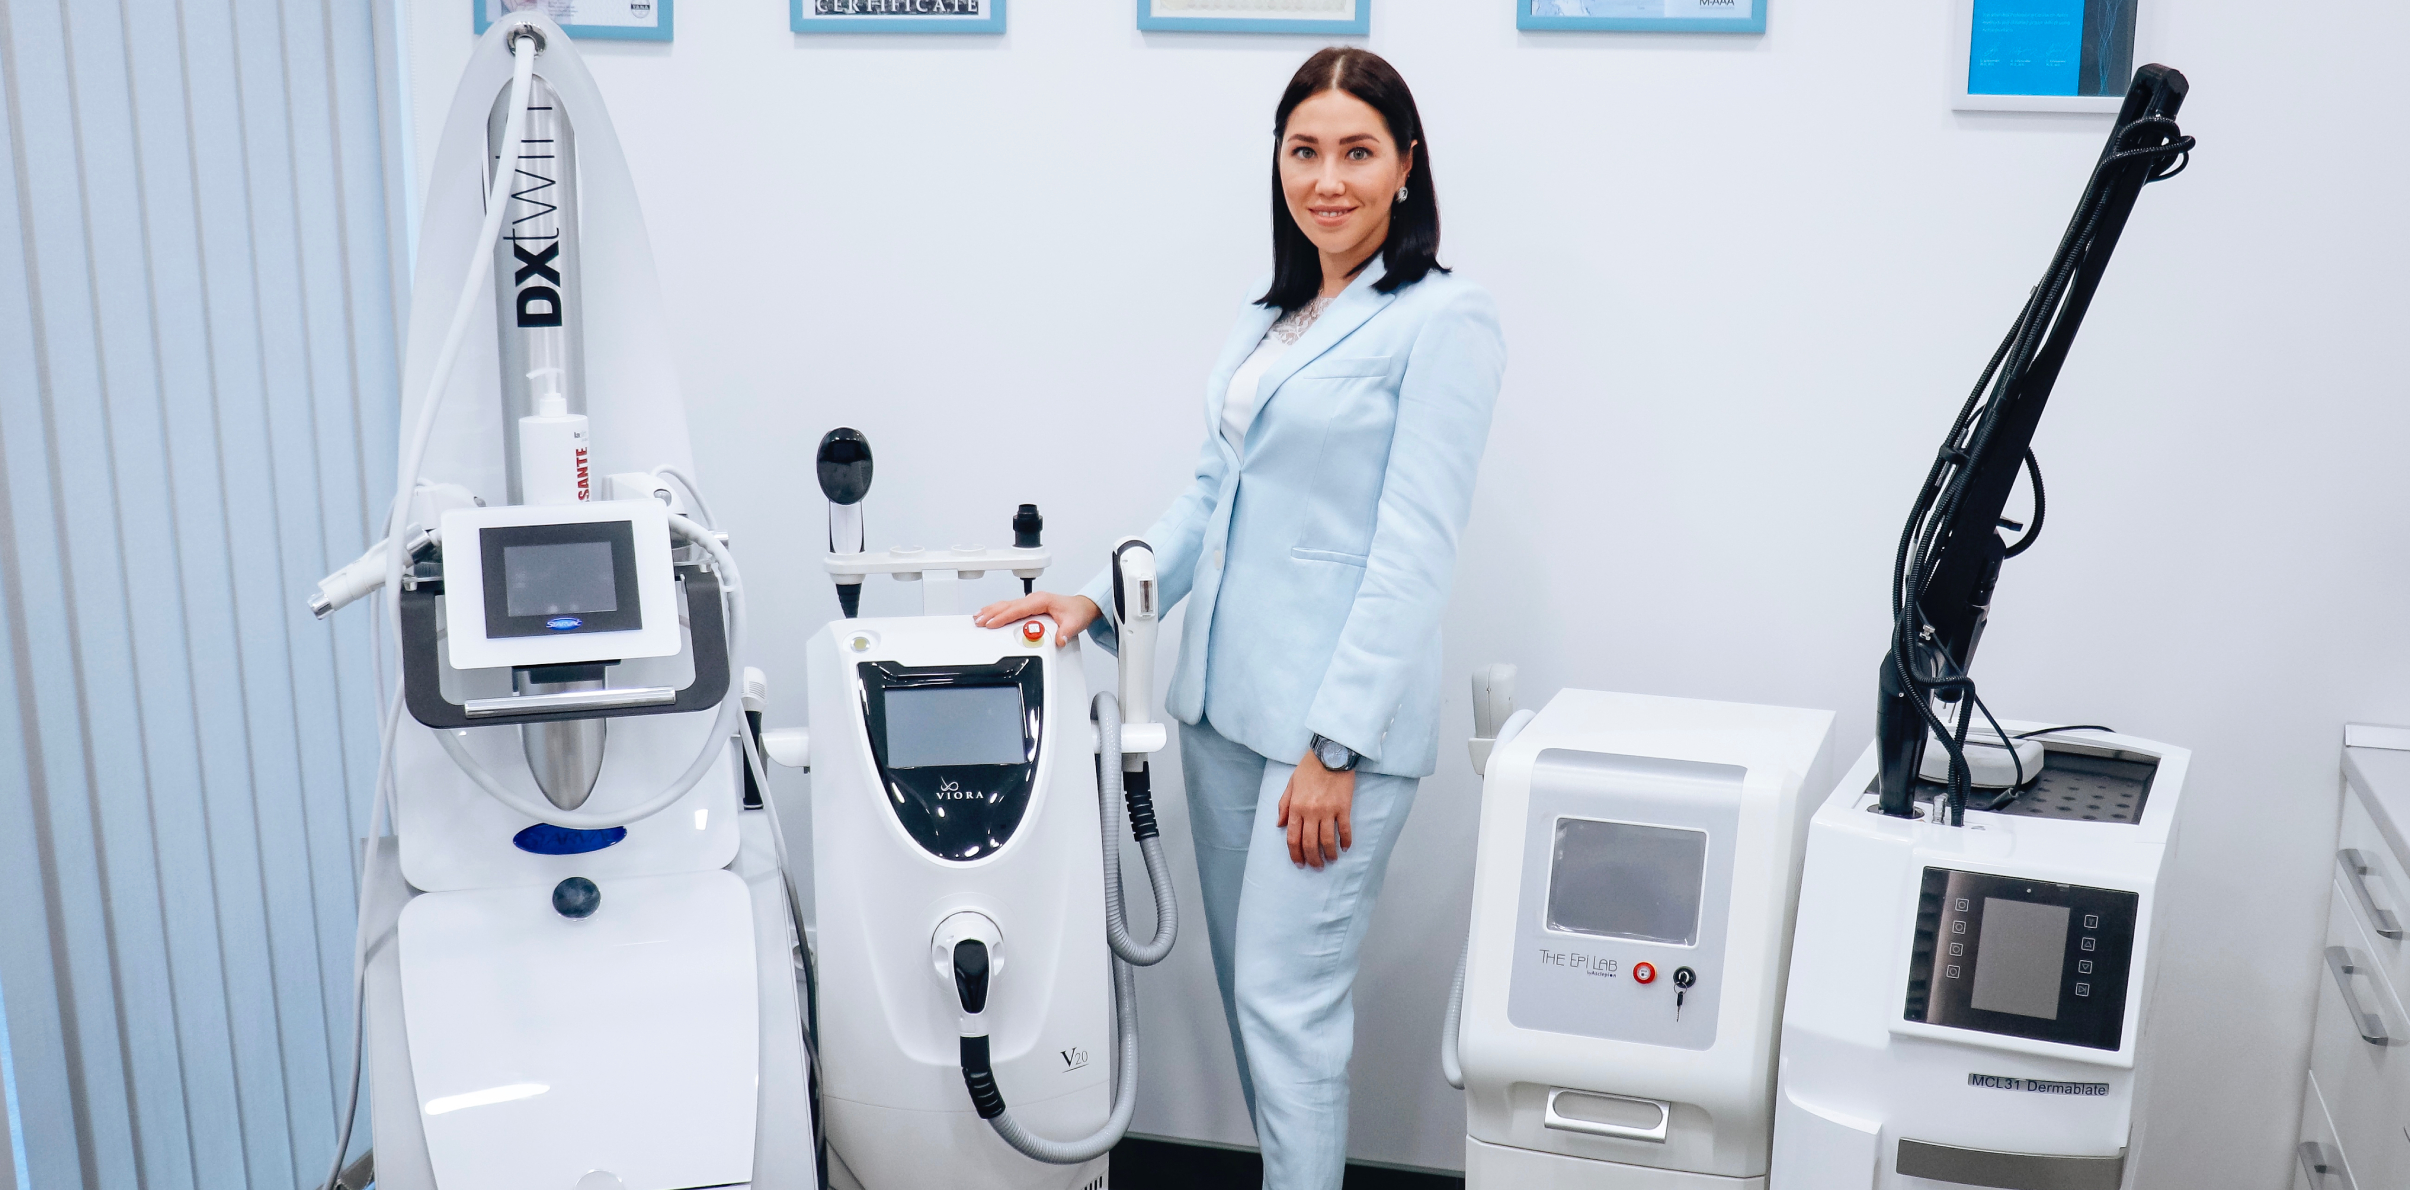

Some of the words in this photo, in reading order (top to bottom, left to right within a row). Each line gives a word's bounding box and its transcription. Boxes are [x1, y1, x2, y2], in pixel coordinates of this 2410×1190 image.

[576, 447, 590, 502] SANTE
[936, 791, 984, 800] VIORA
[1539, 949, 1566, 967] THE
[1592, 955, 1618, 972] LAB
[1060, 1046, 1089, 1068] V20
[1972, 1074, 2020, 1090] MCL31
[2027, 1080, 2107, 1096] Dermablate
